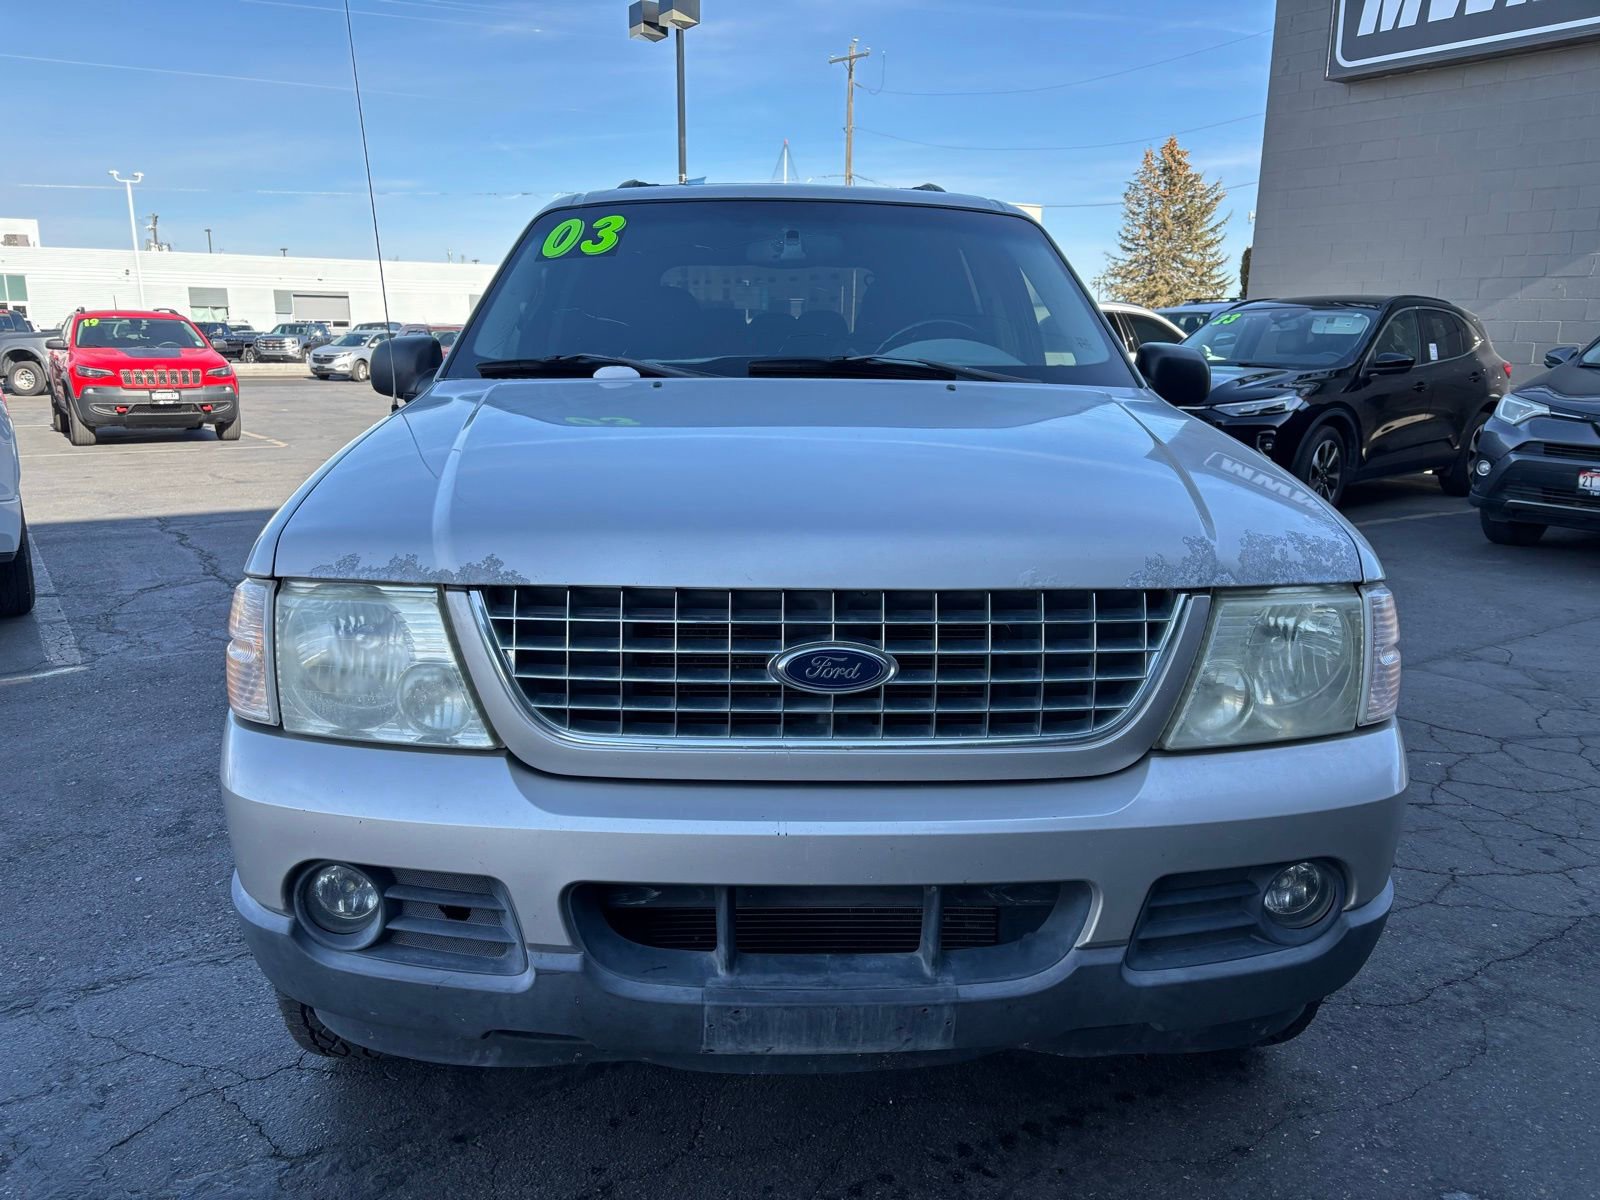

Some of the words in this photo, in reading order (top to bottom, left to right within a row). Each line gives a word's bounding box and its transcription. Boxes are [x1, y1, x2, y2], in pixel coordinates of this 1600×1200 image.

[542, 215, 627, 258] 03
[83, 318, 99, 327] 19
[805, 655, 862, 679] Ford
